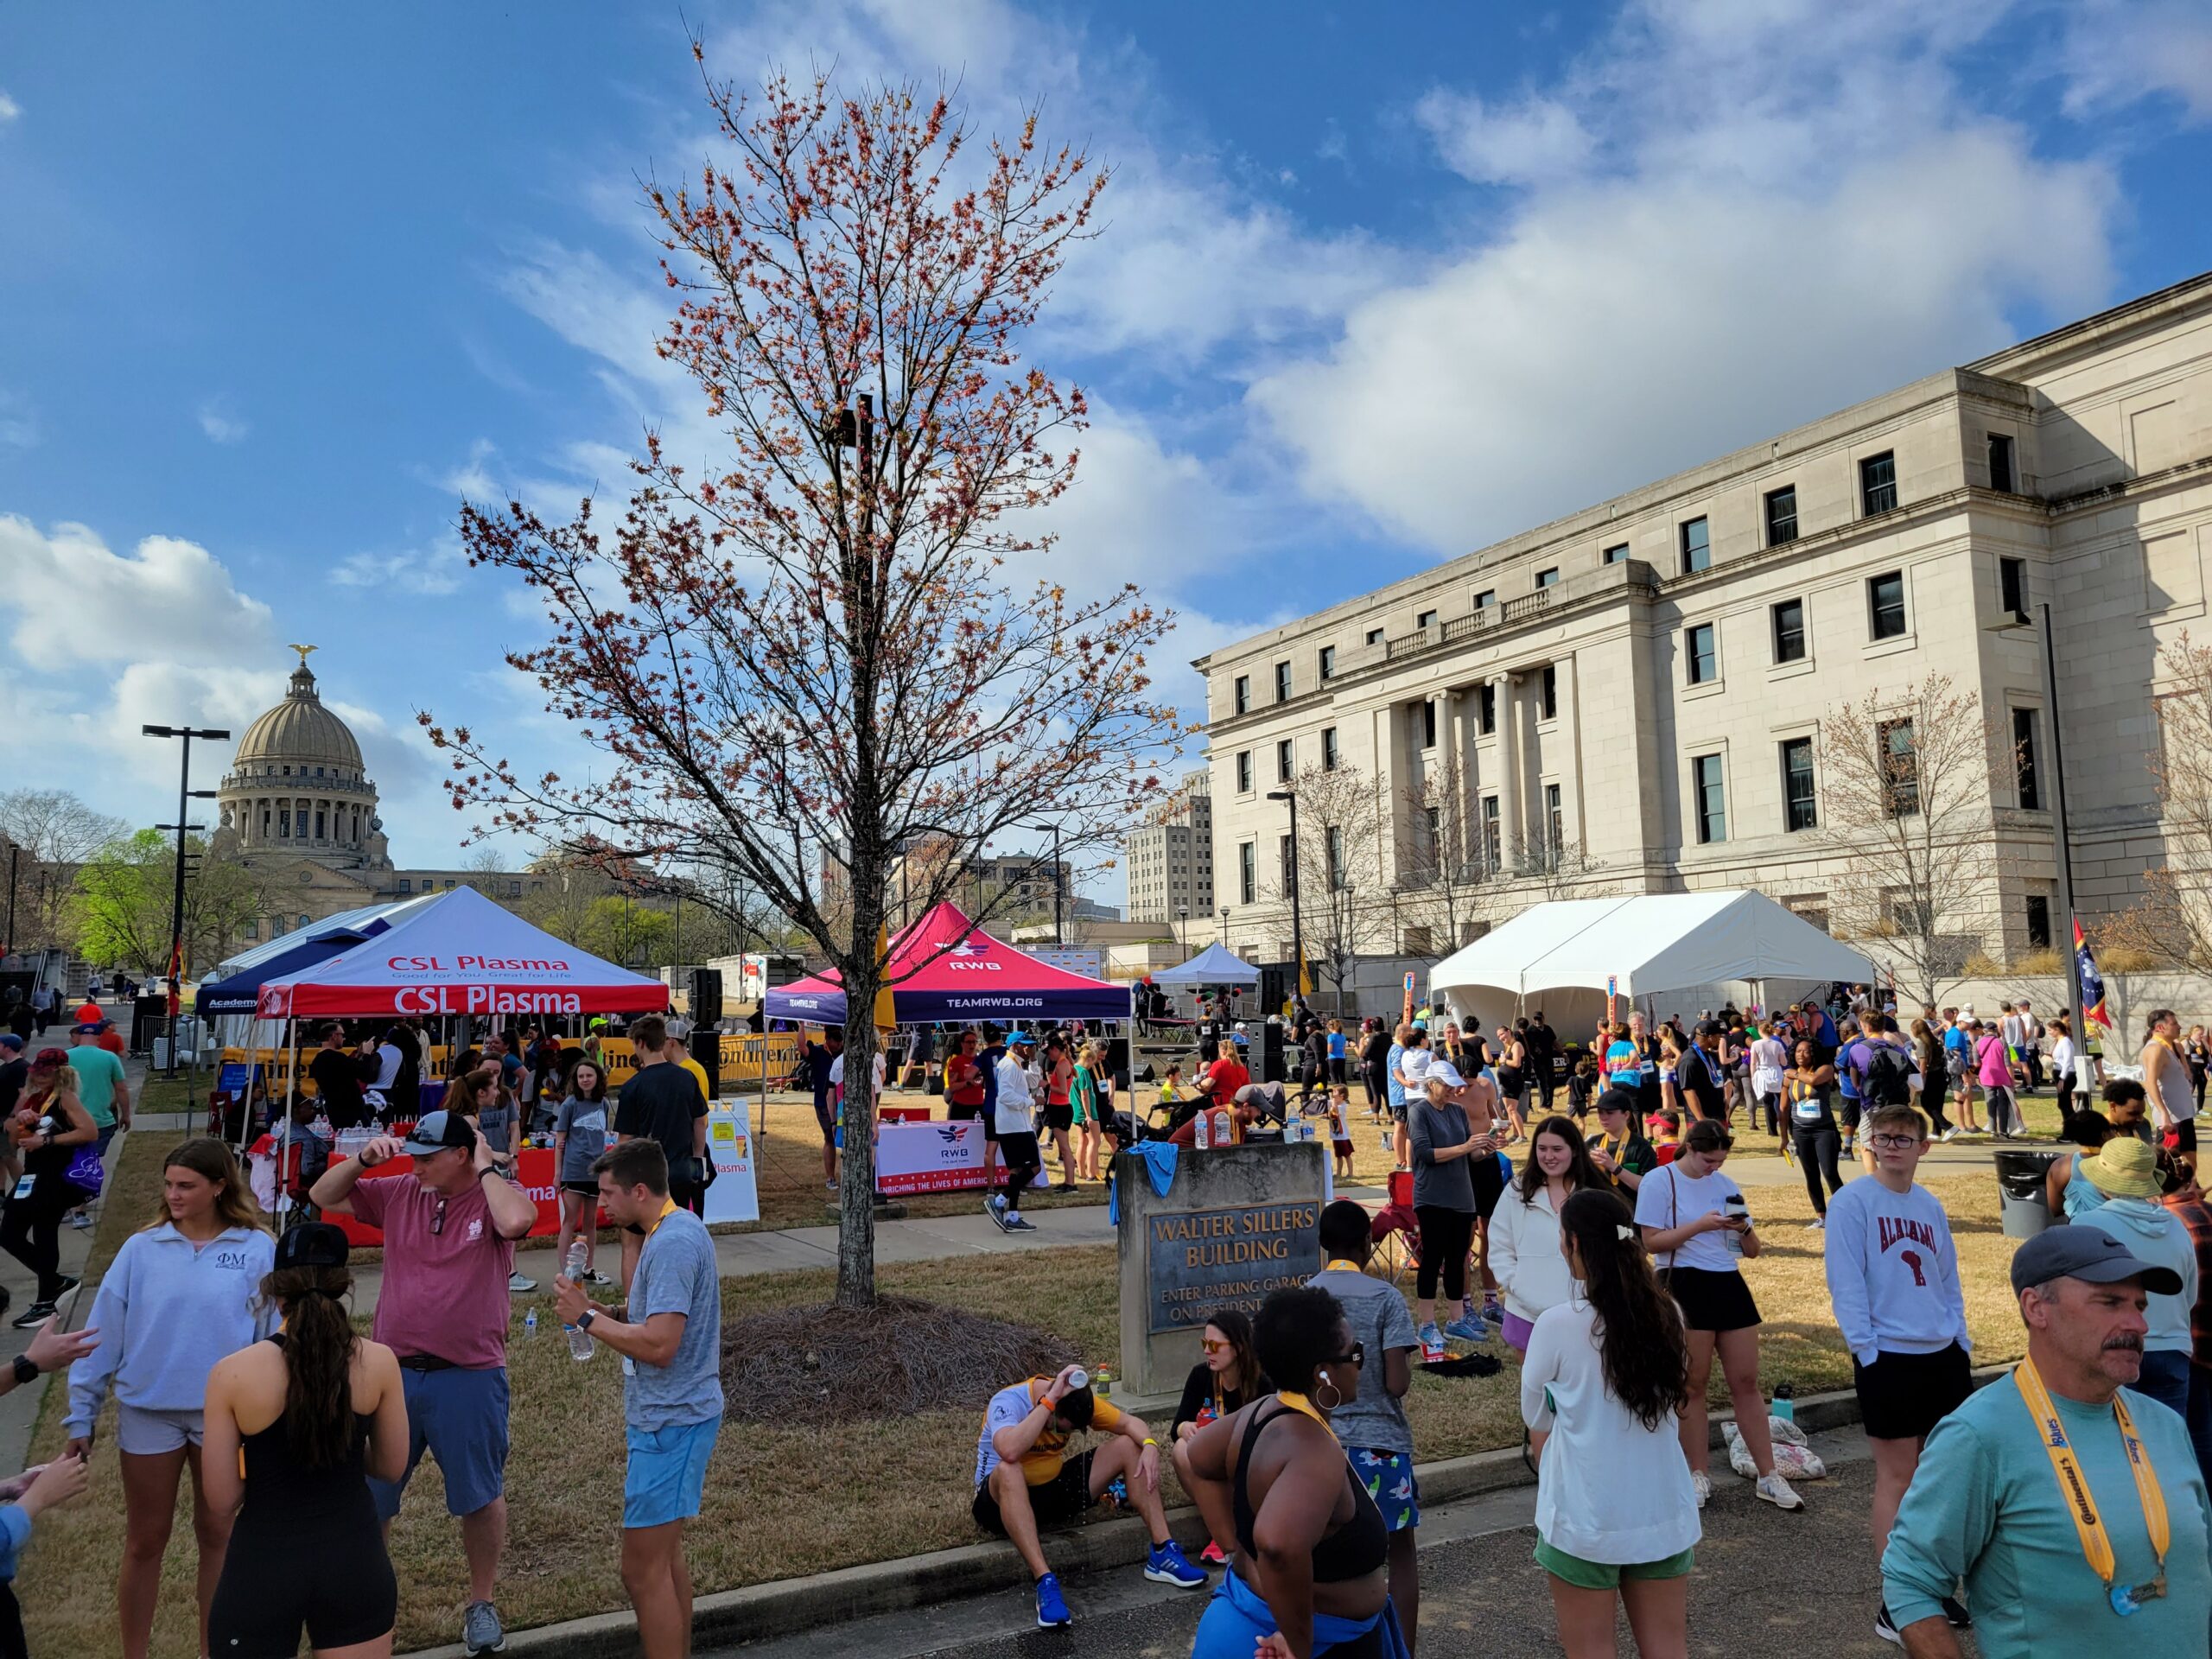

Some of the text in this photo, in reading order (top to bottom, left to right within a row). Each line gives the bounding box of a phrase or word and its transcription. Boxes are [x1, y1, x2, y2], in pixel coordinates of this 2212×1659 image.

[388, 955, 569, 970] CSL Plasma
[949, 962, 1001, 970] RWB
[394, 985, 581, 1014] CSL Plasma
[947, 997, 1043, 1008] TEAMRWB.ORG
[941, 1147, 968, 1158] RWB
[918, 1181, 930, 1191] THE
[932, 1179, 950, 1189] LIVES
[1155, 1208, 1314, 1242] WALTER SILLERS
[1186, 1237, 1287, 1268] BUILDING
[1161, 1285, 1200, 1304] ENTER
[1205, 1280, 1259, 1297] PARKING
[1170, 1307, 1192, 1321] ON
[2063, 1465, 2095, 1525] Continental
